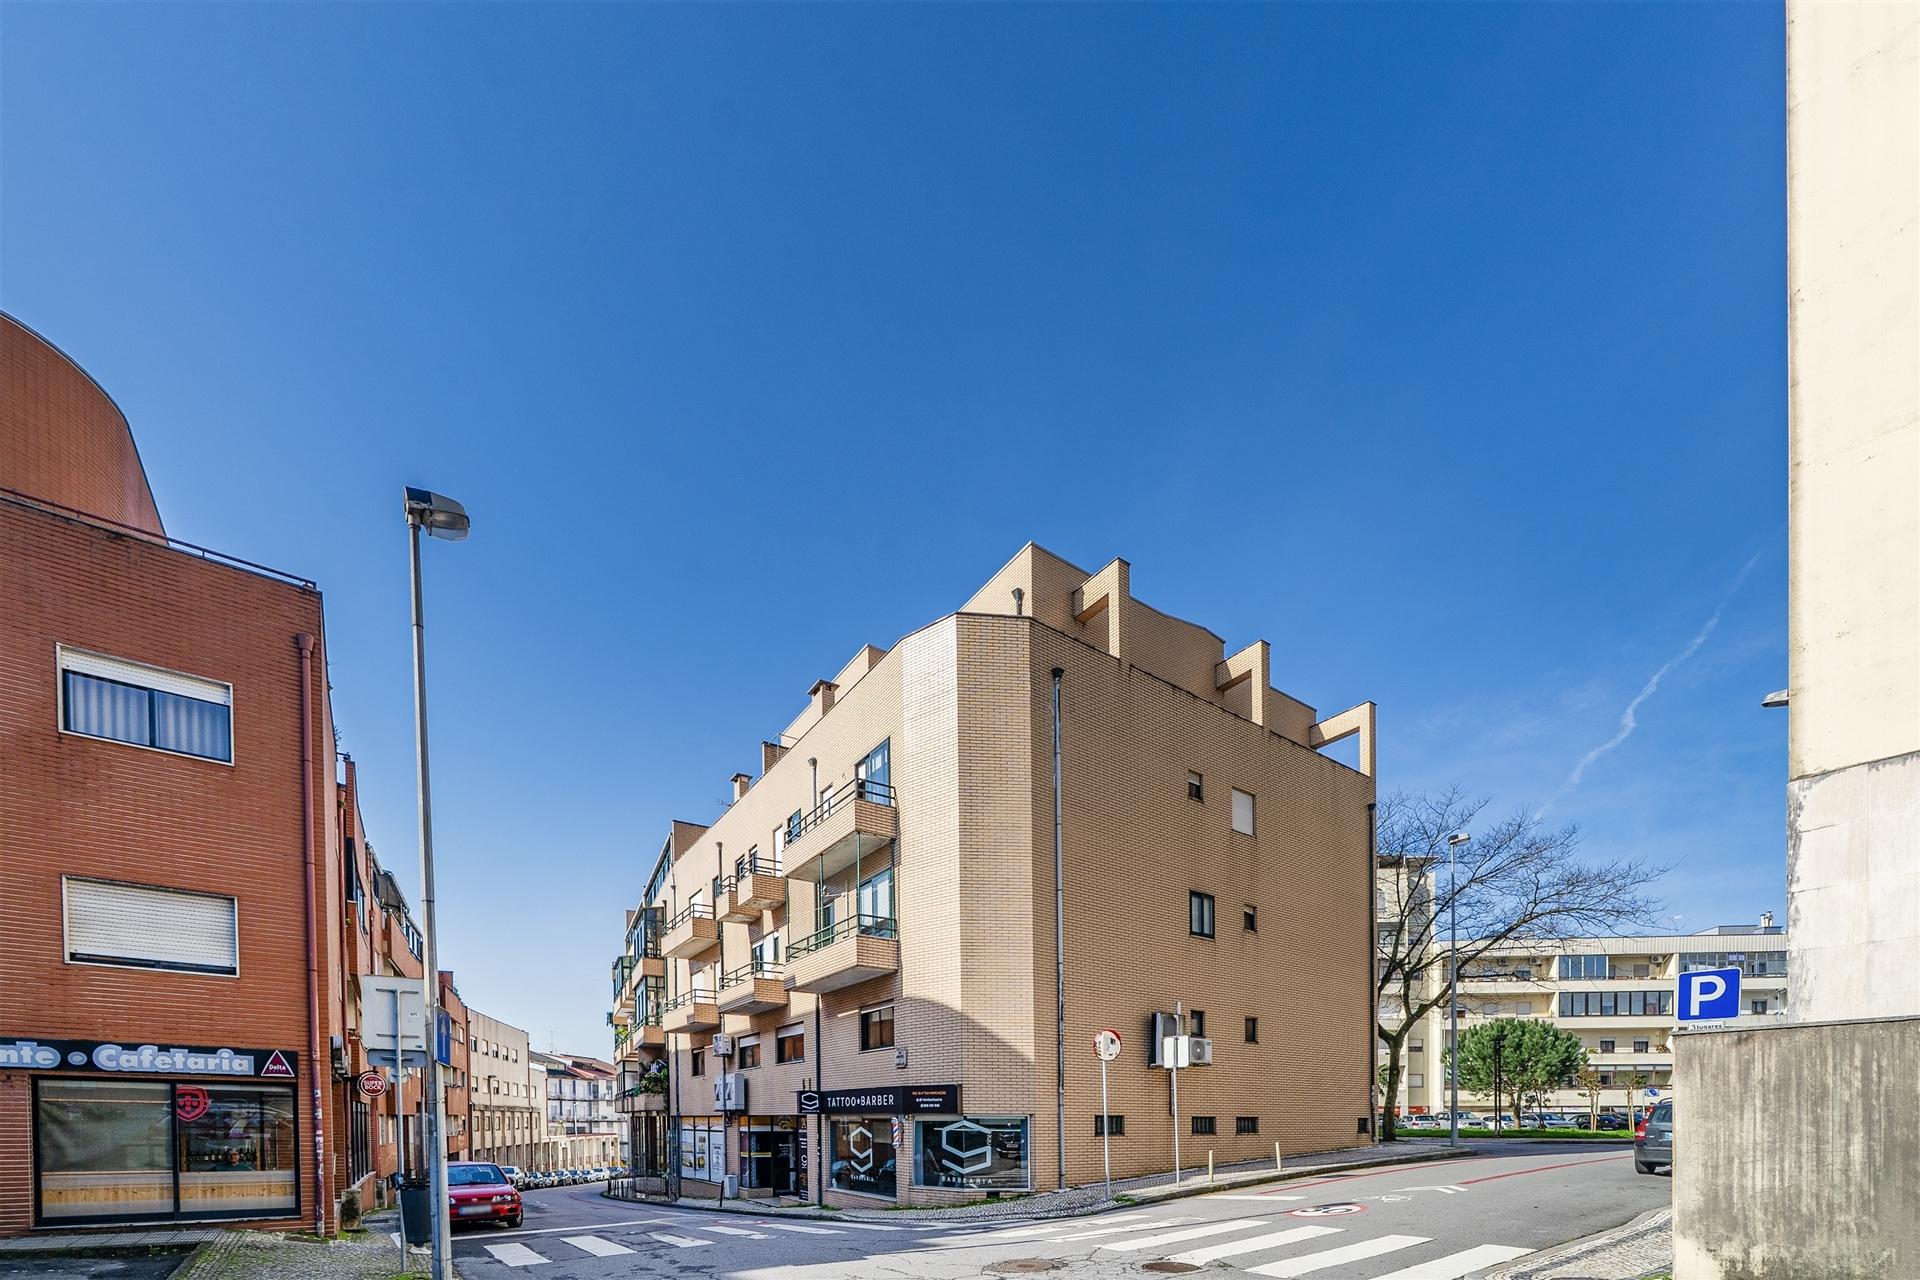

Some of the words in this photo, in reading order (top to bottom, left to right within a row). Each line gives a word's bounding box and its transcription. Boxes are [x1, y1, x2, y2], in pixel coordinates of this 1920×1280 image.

[1690, 975, 1726, 1016] P
[94, 1045, 252, 1074] Cafetaria
[941, 1175, 993, 1185] BARBEARIA
